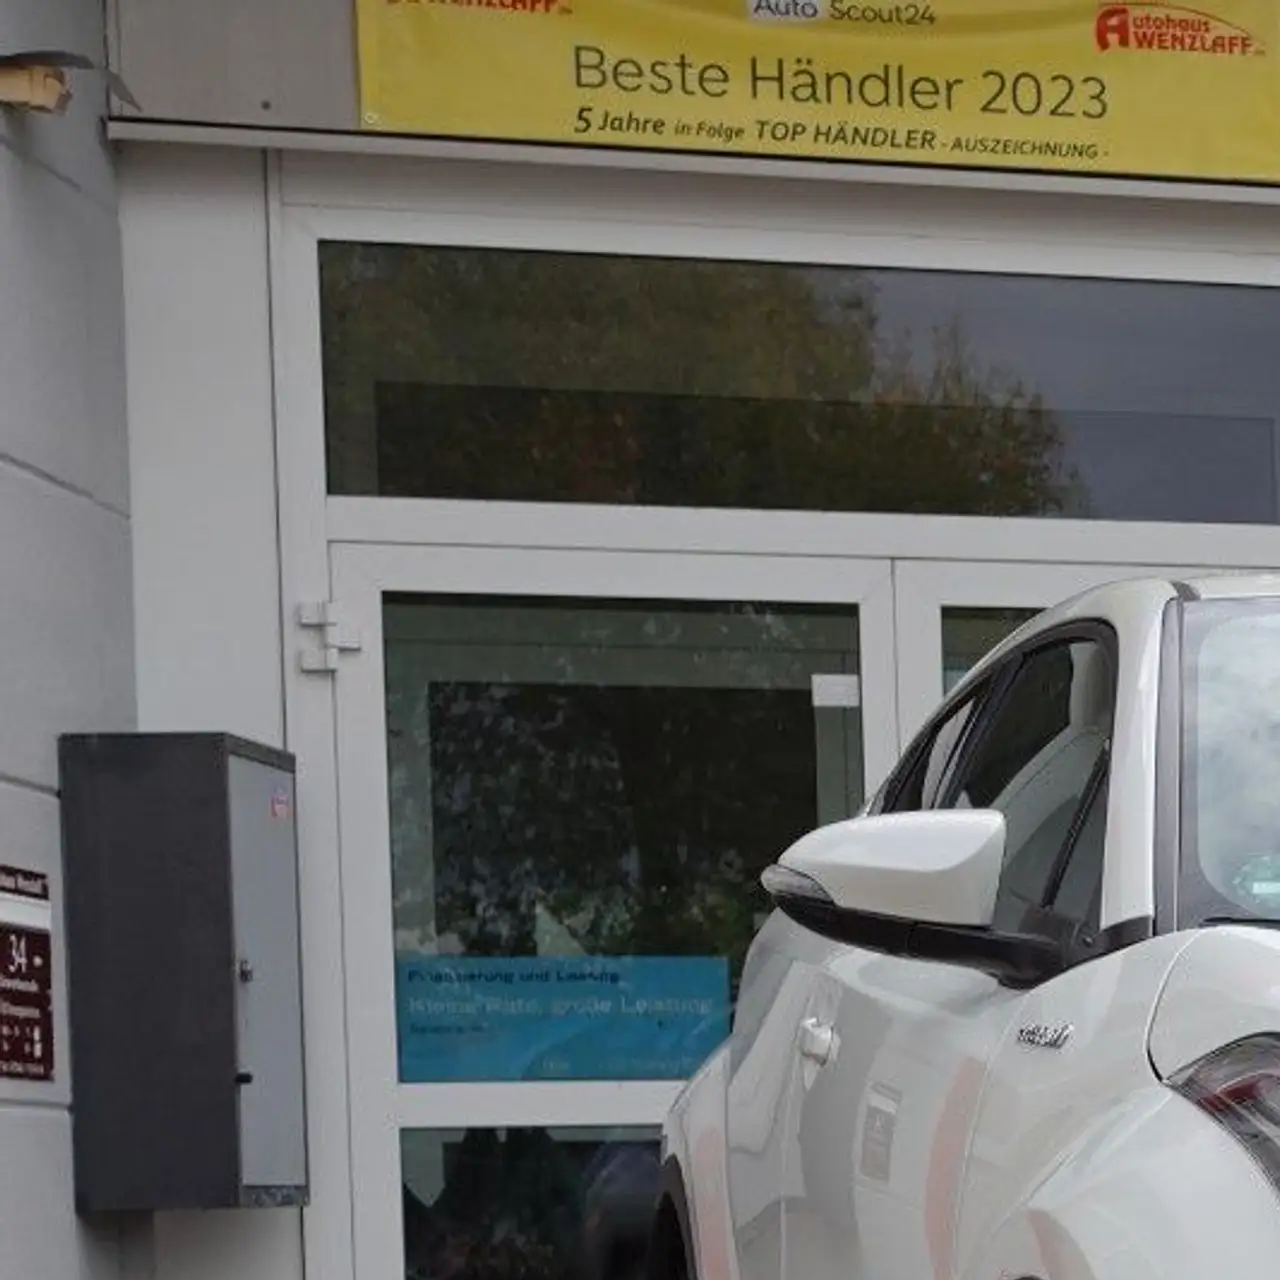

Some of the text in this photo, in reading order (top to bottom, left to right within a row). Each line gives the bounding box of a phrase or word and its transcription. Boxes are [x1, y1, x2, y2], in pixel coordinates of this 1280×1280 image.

[753, 0, 937, 25] Auto Scout24
[574, 45, 1108, 119] Beste Händler 2023
[574, 107, 594, 134] 5
[598, 109, 665, 136] Jahre
[674, 119, 691, 136] in
[695, 120, 746, 143] Folge
[755, 119, 807, 142] TOP
[813, 120, 937, 149] HÄNDLER
[951, 136, 1099, 160] AUSZEICHNUNG
